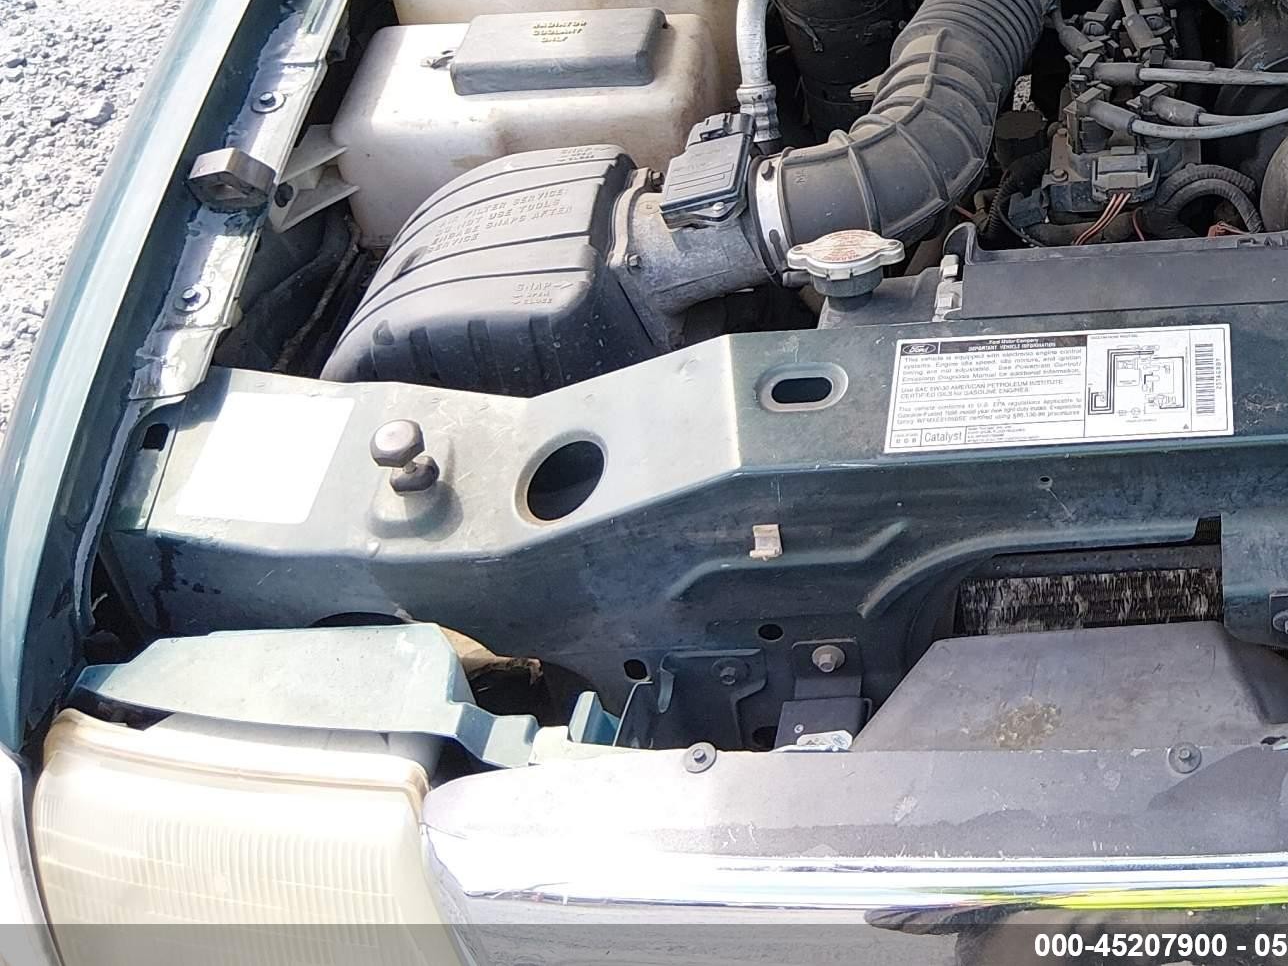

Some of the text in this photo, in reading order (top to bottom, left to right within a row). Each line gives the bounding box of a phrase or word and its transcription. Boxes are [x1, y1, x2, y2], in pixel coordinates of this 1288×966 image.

[466, 201, 507, 217] FILTER
[488, 209, 513, 221] USE
[518, 199, 561, 213] TOOLS
[486, 215, 527, 230] SNAPS
[531, 207, 573, 221] AFTER
[908, 344, 930, 353] Ford
[924, 431, 962, 443] Catalyst
